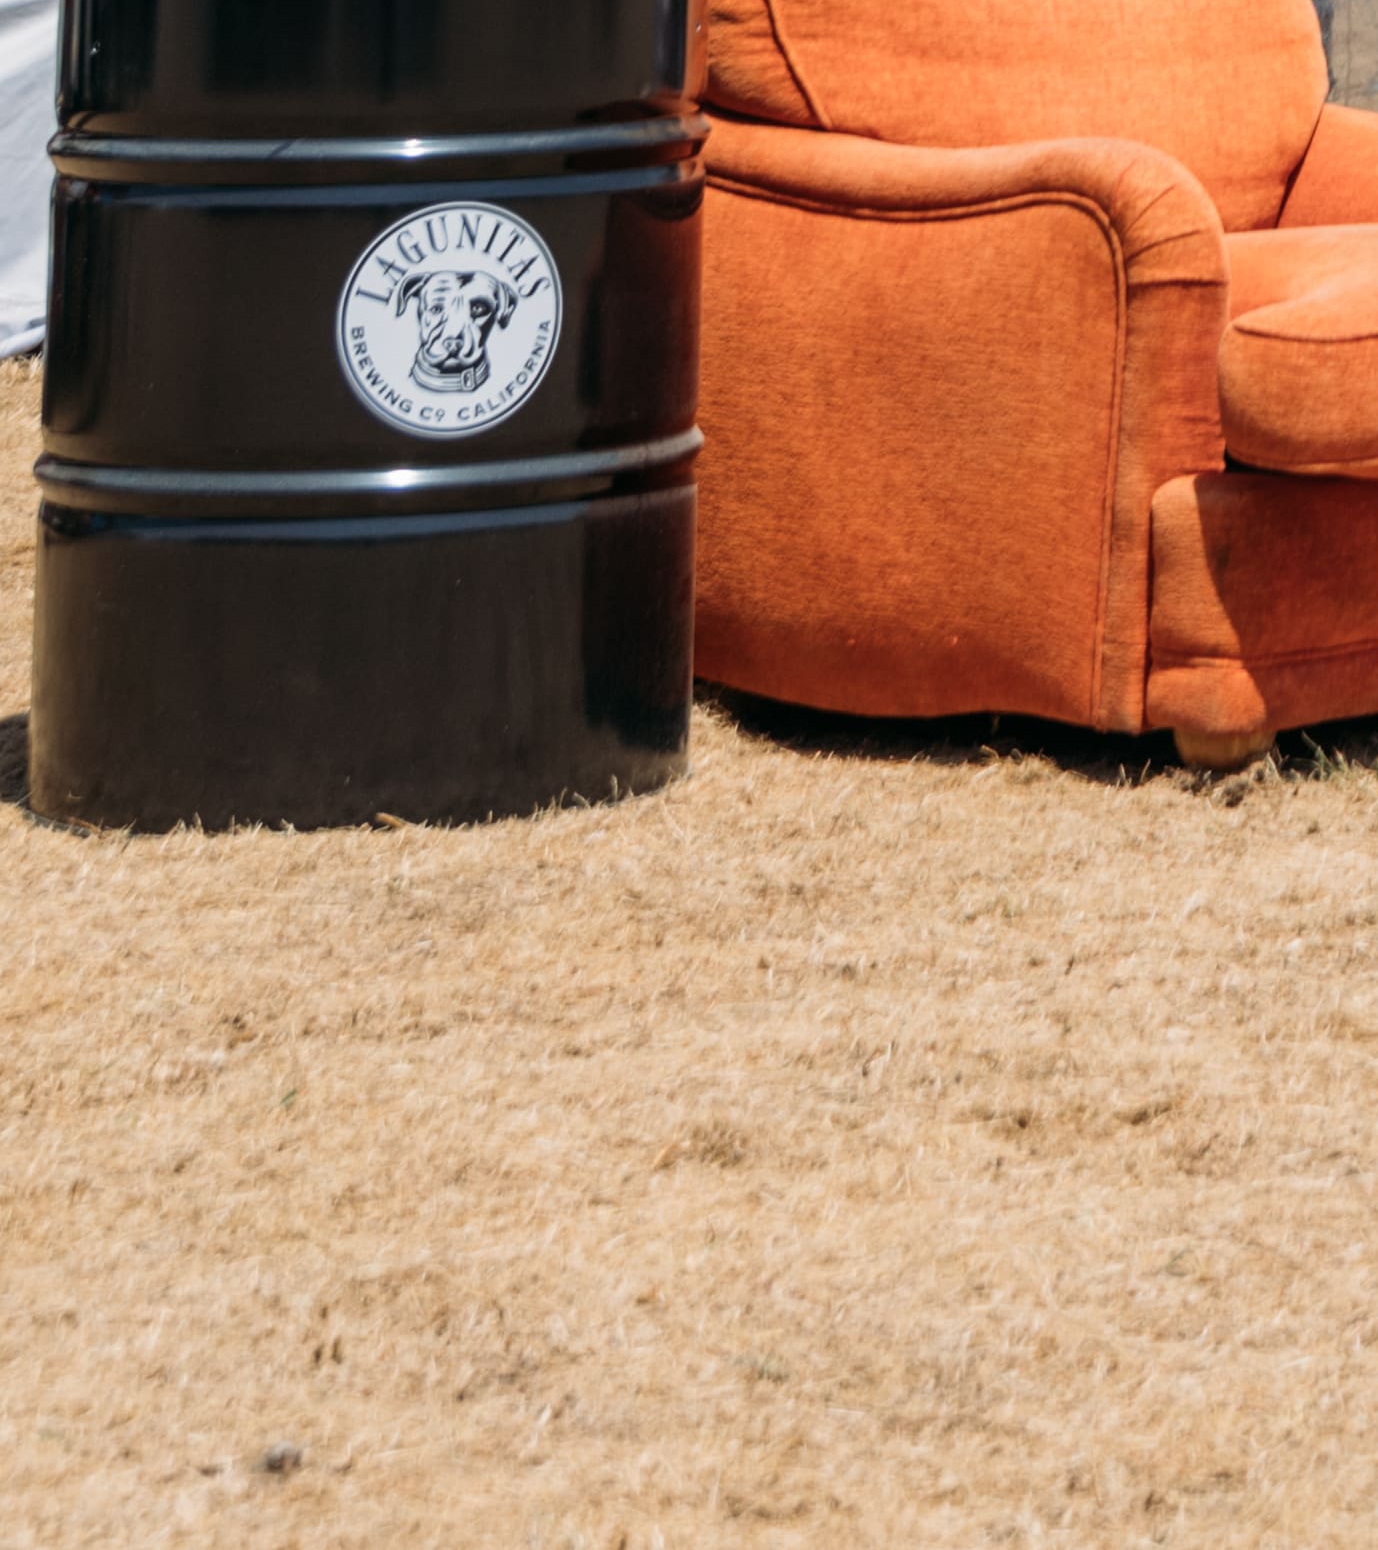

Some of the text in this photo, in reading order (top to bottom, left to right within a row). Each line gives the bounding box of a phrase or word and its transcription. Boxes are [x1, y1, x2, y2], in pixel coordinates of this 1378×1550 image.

[355, 213, 551, 306] LAGUNITAS
[351, 325, 413, 414] BREWING
[457, 319, 552, 421] CALIFORNIA
